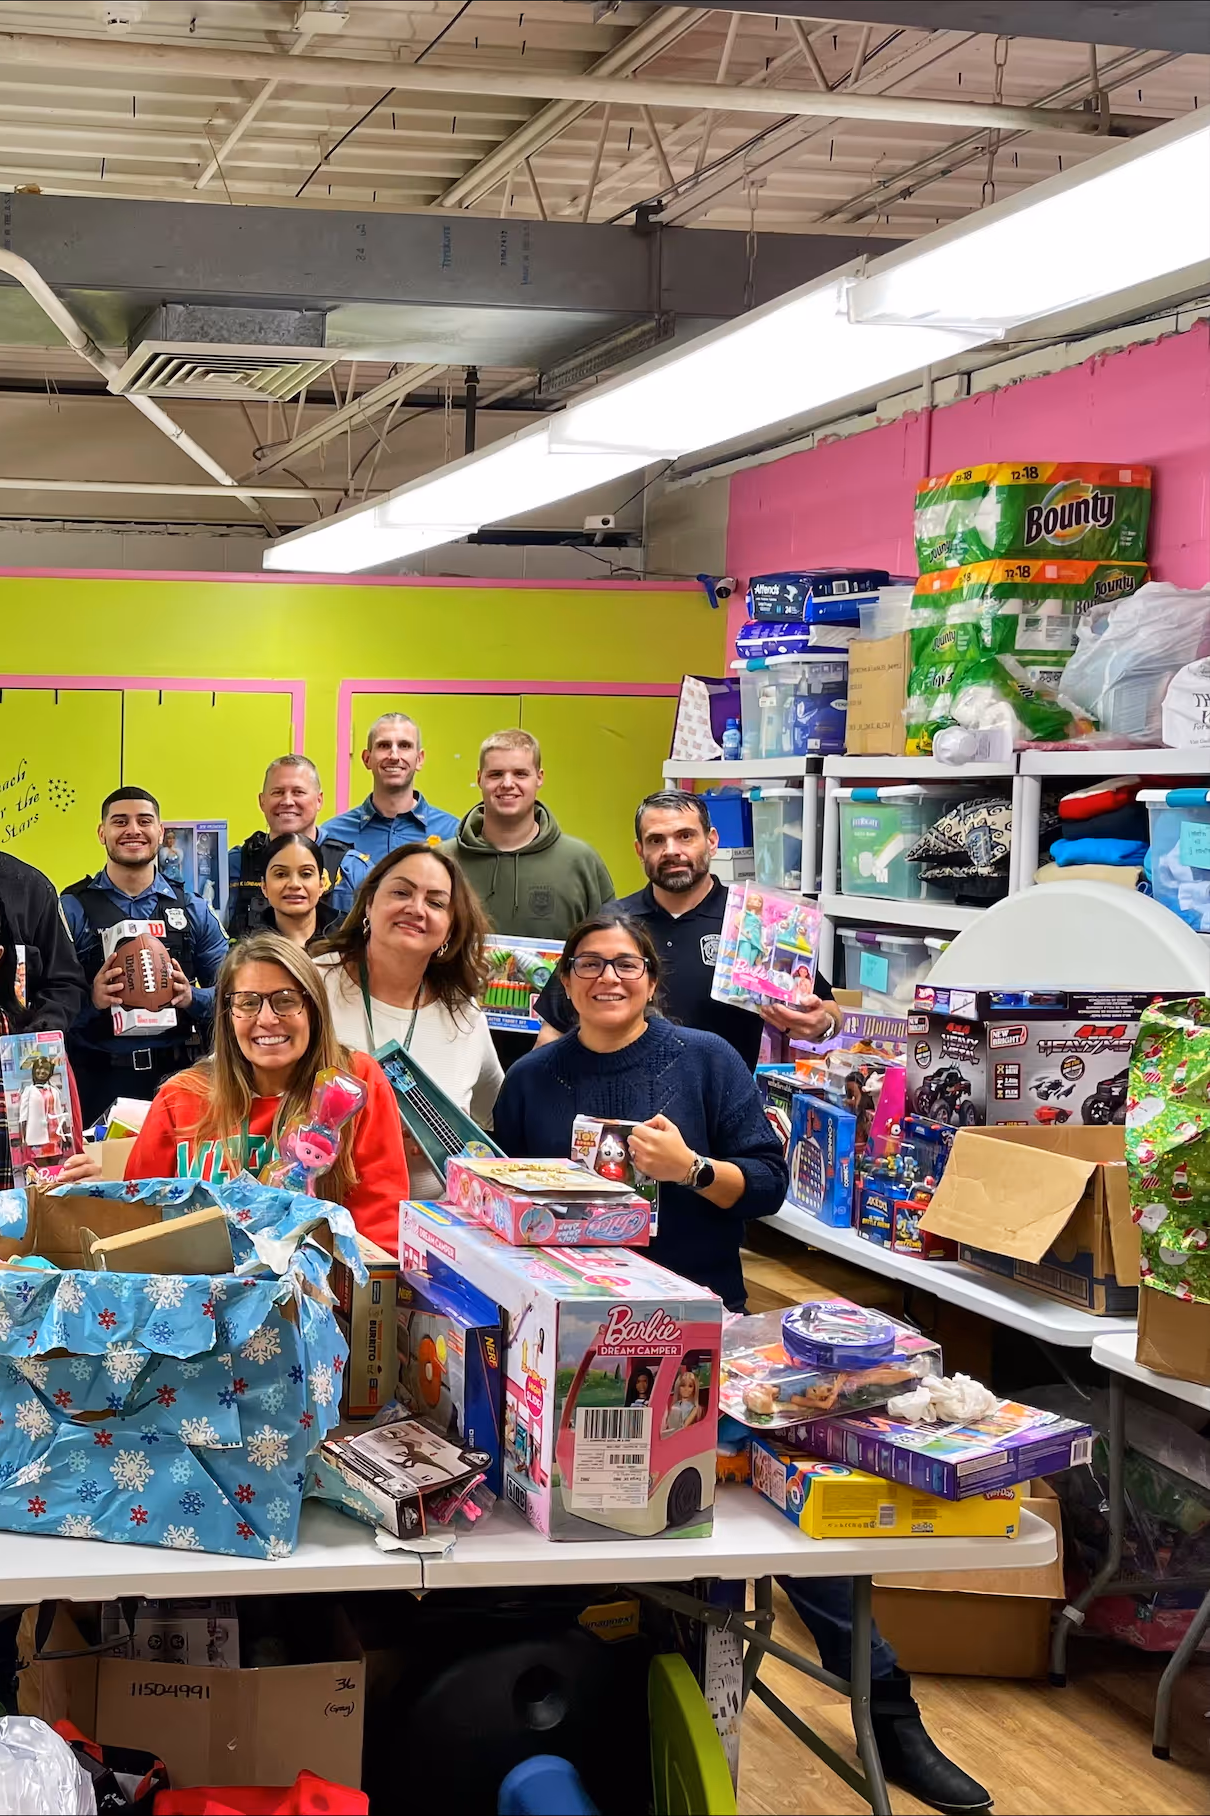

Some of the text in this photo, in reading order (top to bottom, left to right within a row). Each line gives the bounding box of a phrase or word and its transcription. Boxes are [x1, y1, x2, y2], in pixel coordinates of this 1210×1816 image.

[1025, 490, 1115, 546] Bounty
[15, 782, 40, 812] the
[1, 812, 39, 844] Stars
[875, 868, 889, 884] M
[125, 954, 135, 993] Wilson
[160, 953, 168, 988] Wilson
[992, 1030, 1009, 1039] NEW
[992, 1035, 1020, 1046] BRIGHT
[574, 1129, 599, 1142] TOY
[578, 1146, 590, 1157] 4
[368, 1320, 377, 1361] BURRITO
[604, 1304, 682, 1347] Barbie
[485, 1336, 499, 1368] NERF
[601, 1346, 678, 1355] DREAM CAMPER
[335, 1677, 356, 1692] 36
